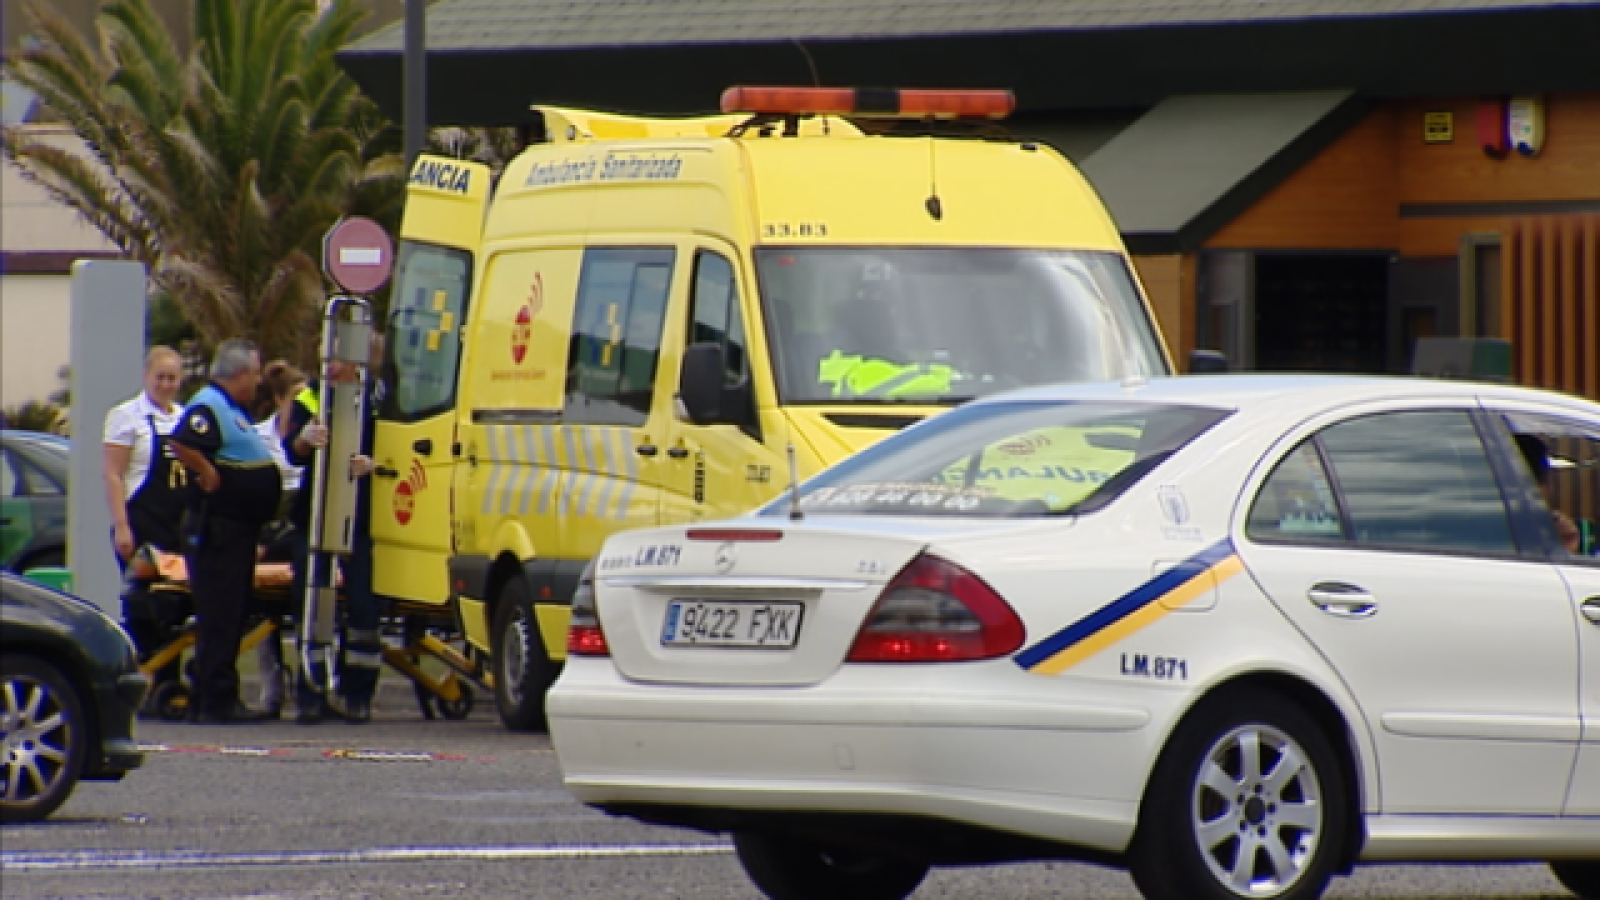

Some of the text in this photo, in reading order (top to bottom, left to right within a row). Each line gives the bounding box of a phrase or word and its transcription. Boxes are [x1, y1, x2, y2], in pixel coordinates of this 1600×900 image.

[410, 159, 471, 194] ANCIA
[682, 606, 796, 639] 9422 FXK
